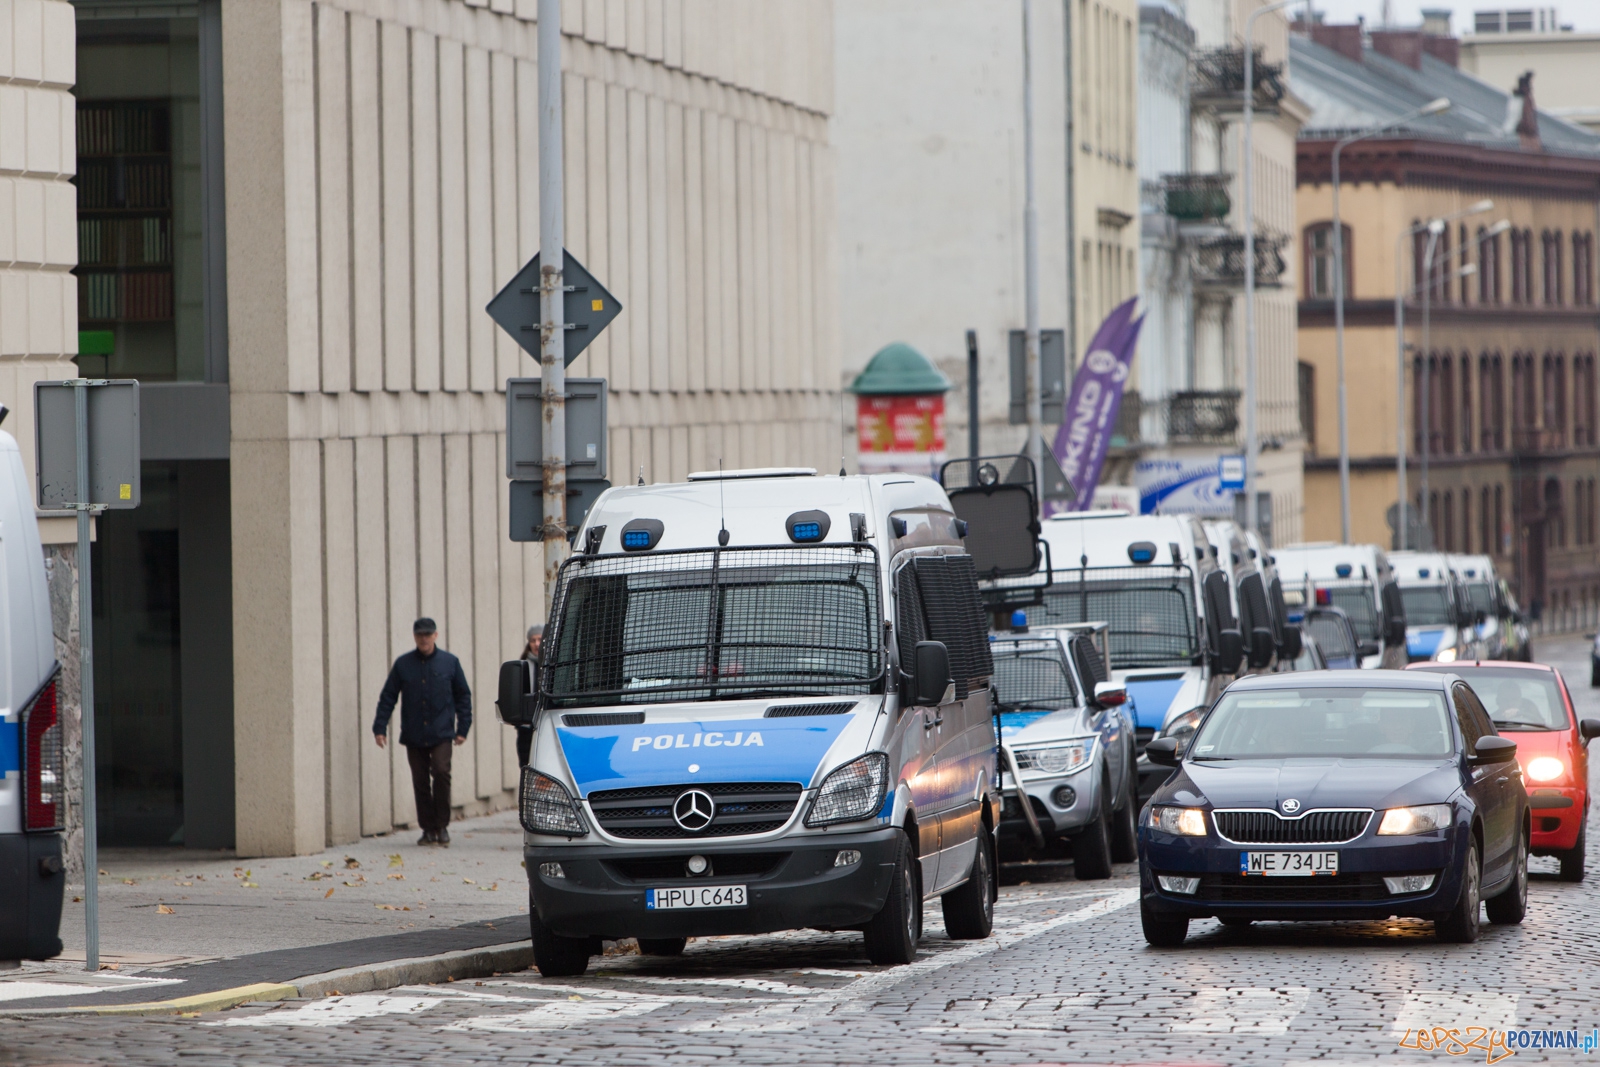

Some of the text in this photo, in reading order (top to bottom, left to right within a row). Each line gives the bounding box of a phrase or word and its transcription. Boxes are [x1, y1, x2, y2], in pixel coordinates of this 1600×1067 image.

[631, 732, 764, 752] POLICJA
[1251, 853, 1336, 871] WE 734JE
[657, 887, 744, 908] HPU C643
